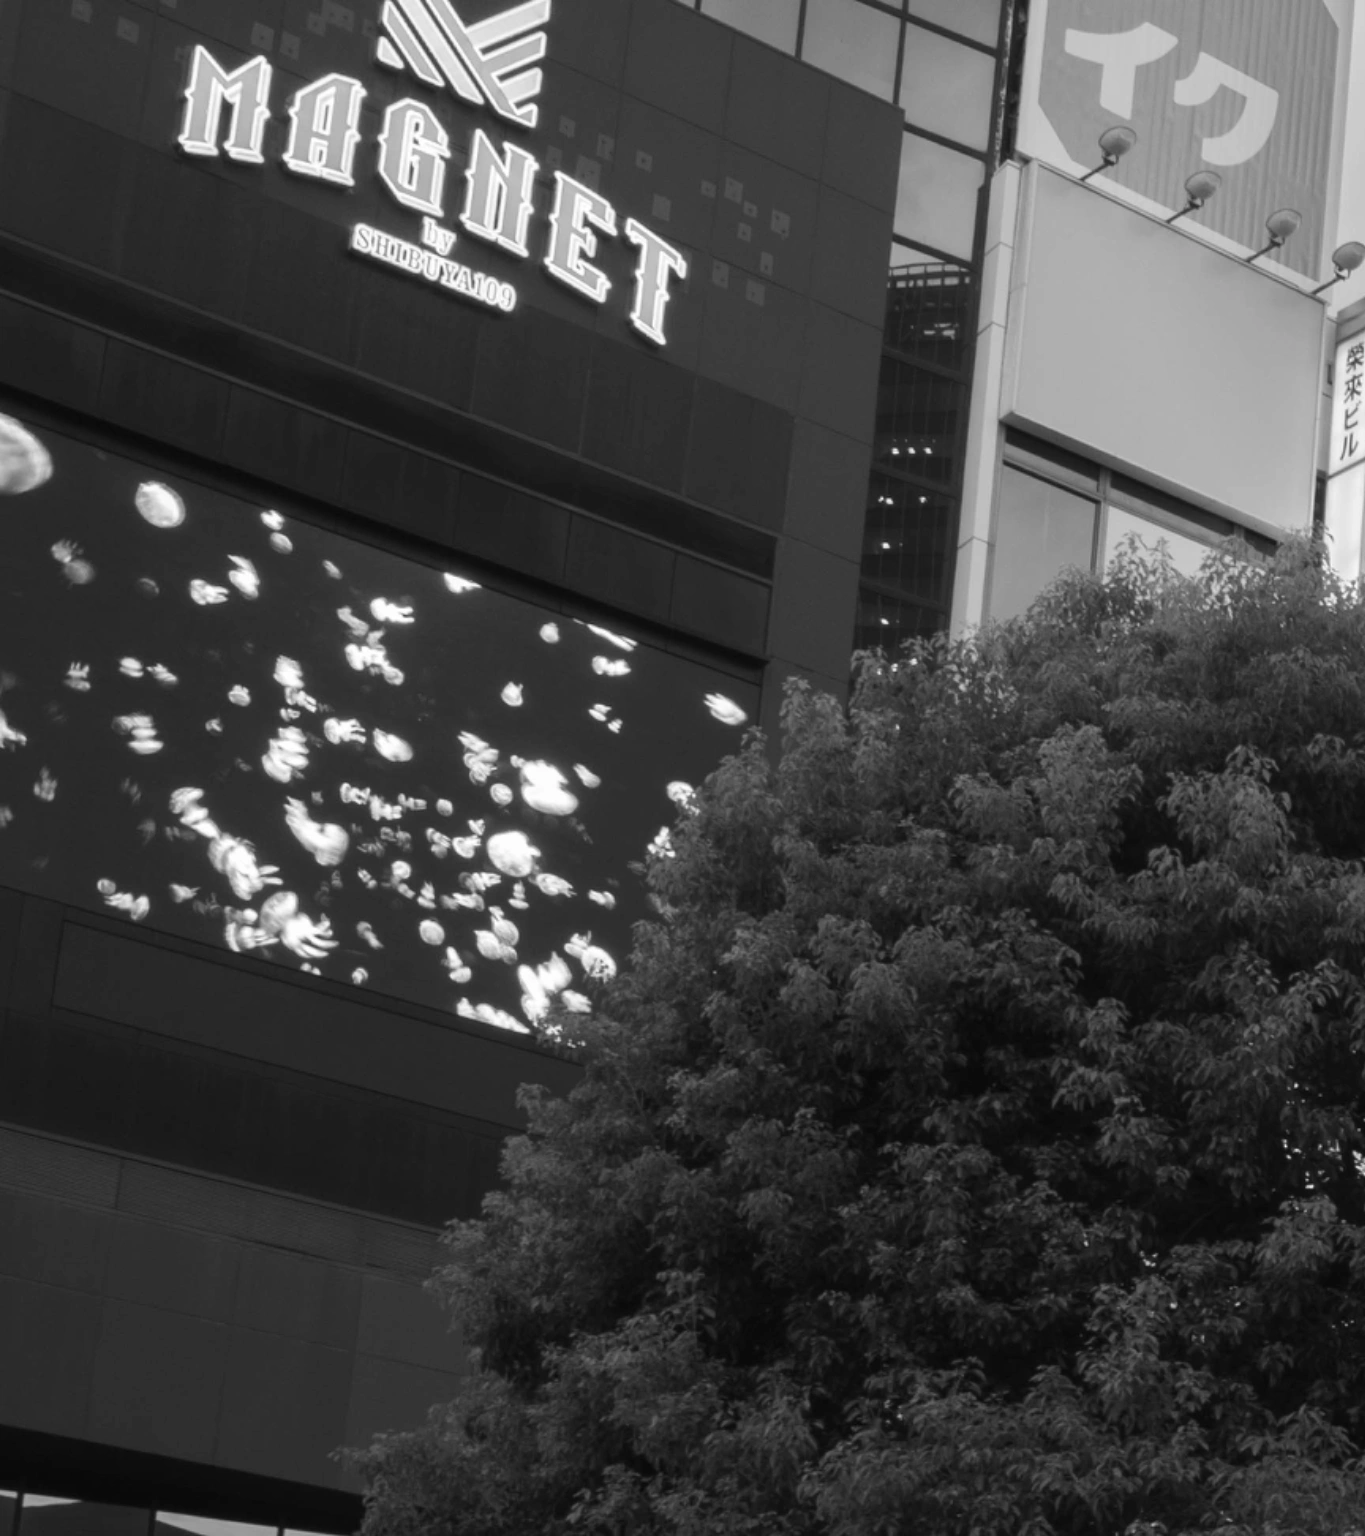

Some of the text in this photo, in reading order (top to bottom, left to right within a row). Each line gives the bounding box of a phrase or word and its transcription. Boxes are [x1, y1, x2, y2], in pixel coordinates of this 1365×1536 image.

[178, 45, 687, 346] MAGNET
[422, 217, 457, 255] by
[351, 223, 517, 312] SHIBUYA109
